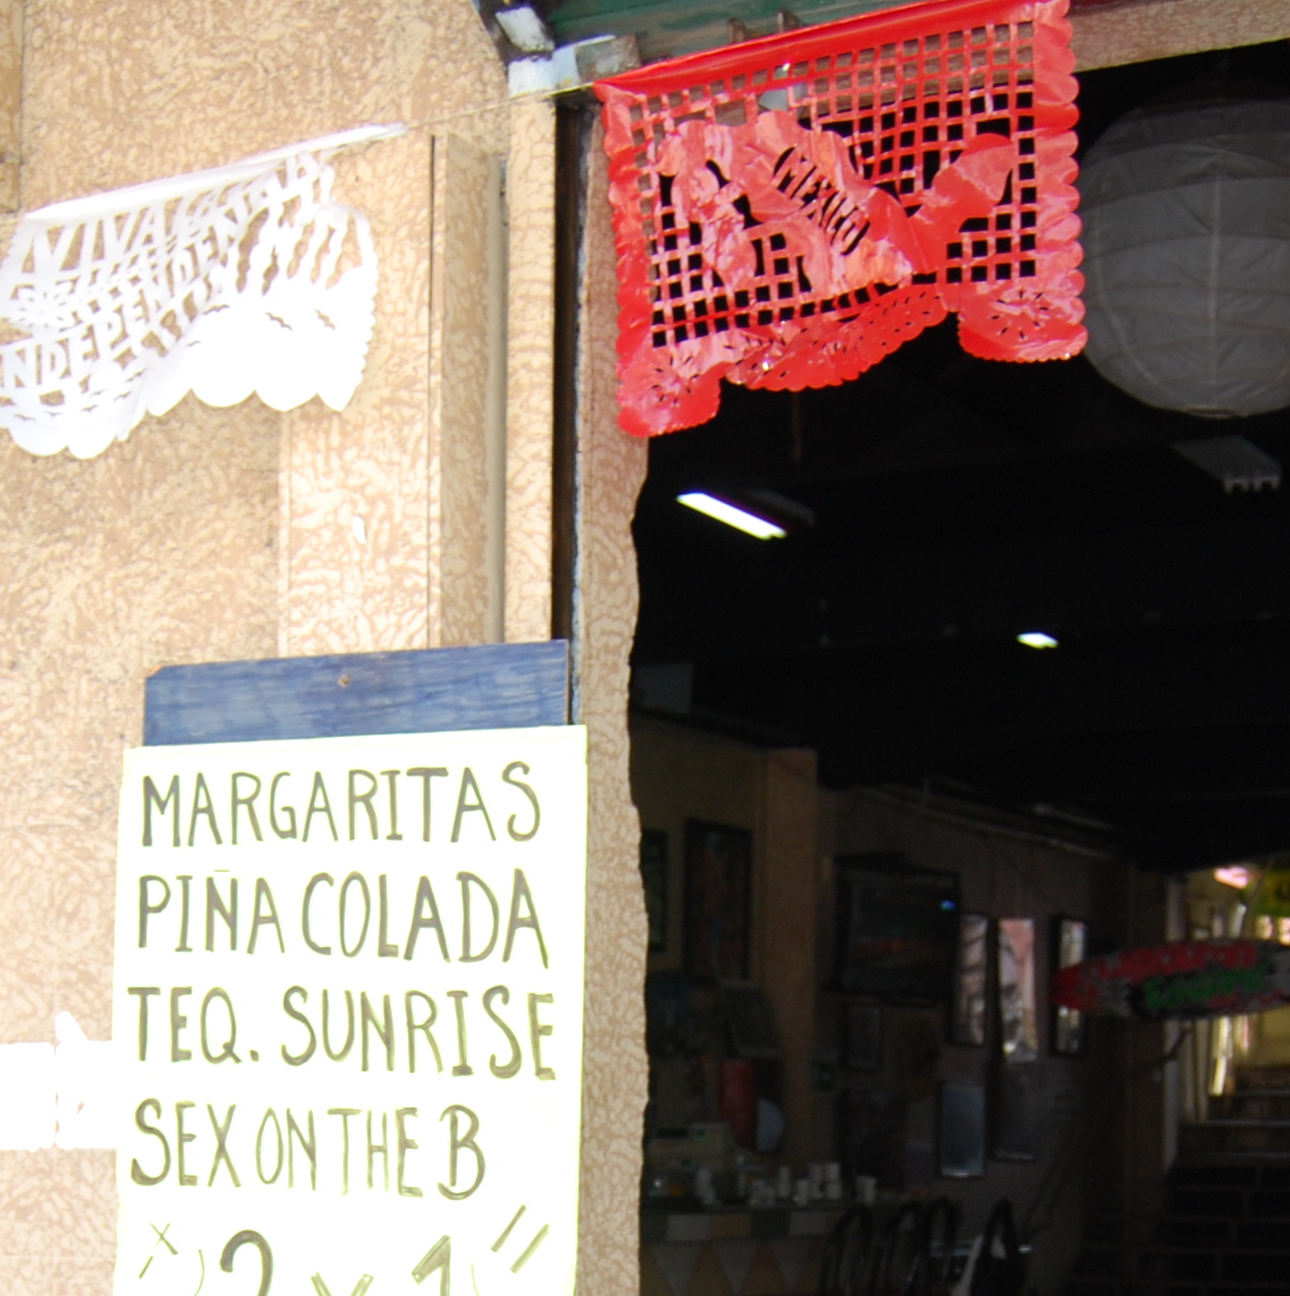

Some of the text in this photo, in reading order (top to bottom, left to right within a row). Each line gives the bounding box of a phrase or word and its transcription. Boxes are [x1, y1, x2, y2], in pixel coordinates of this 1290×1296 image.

[33, 200, 166, 273] VIVA
[142, 761, 541, 848] MARGARITAS
[138, 867, 549, 969] PIÑA COLADA
[127, 984, 556, 1081] TEQ. SUNRISE
[130, 1098, 486, 1200] SEX ON THE B
